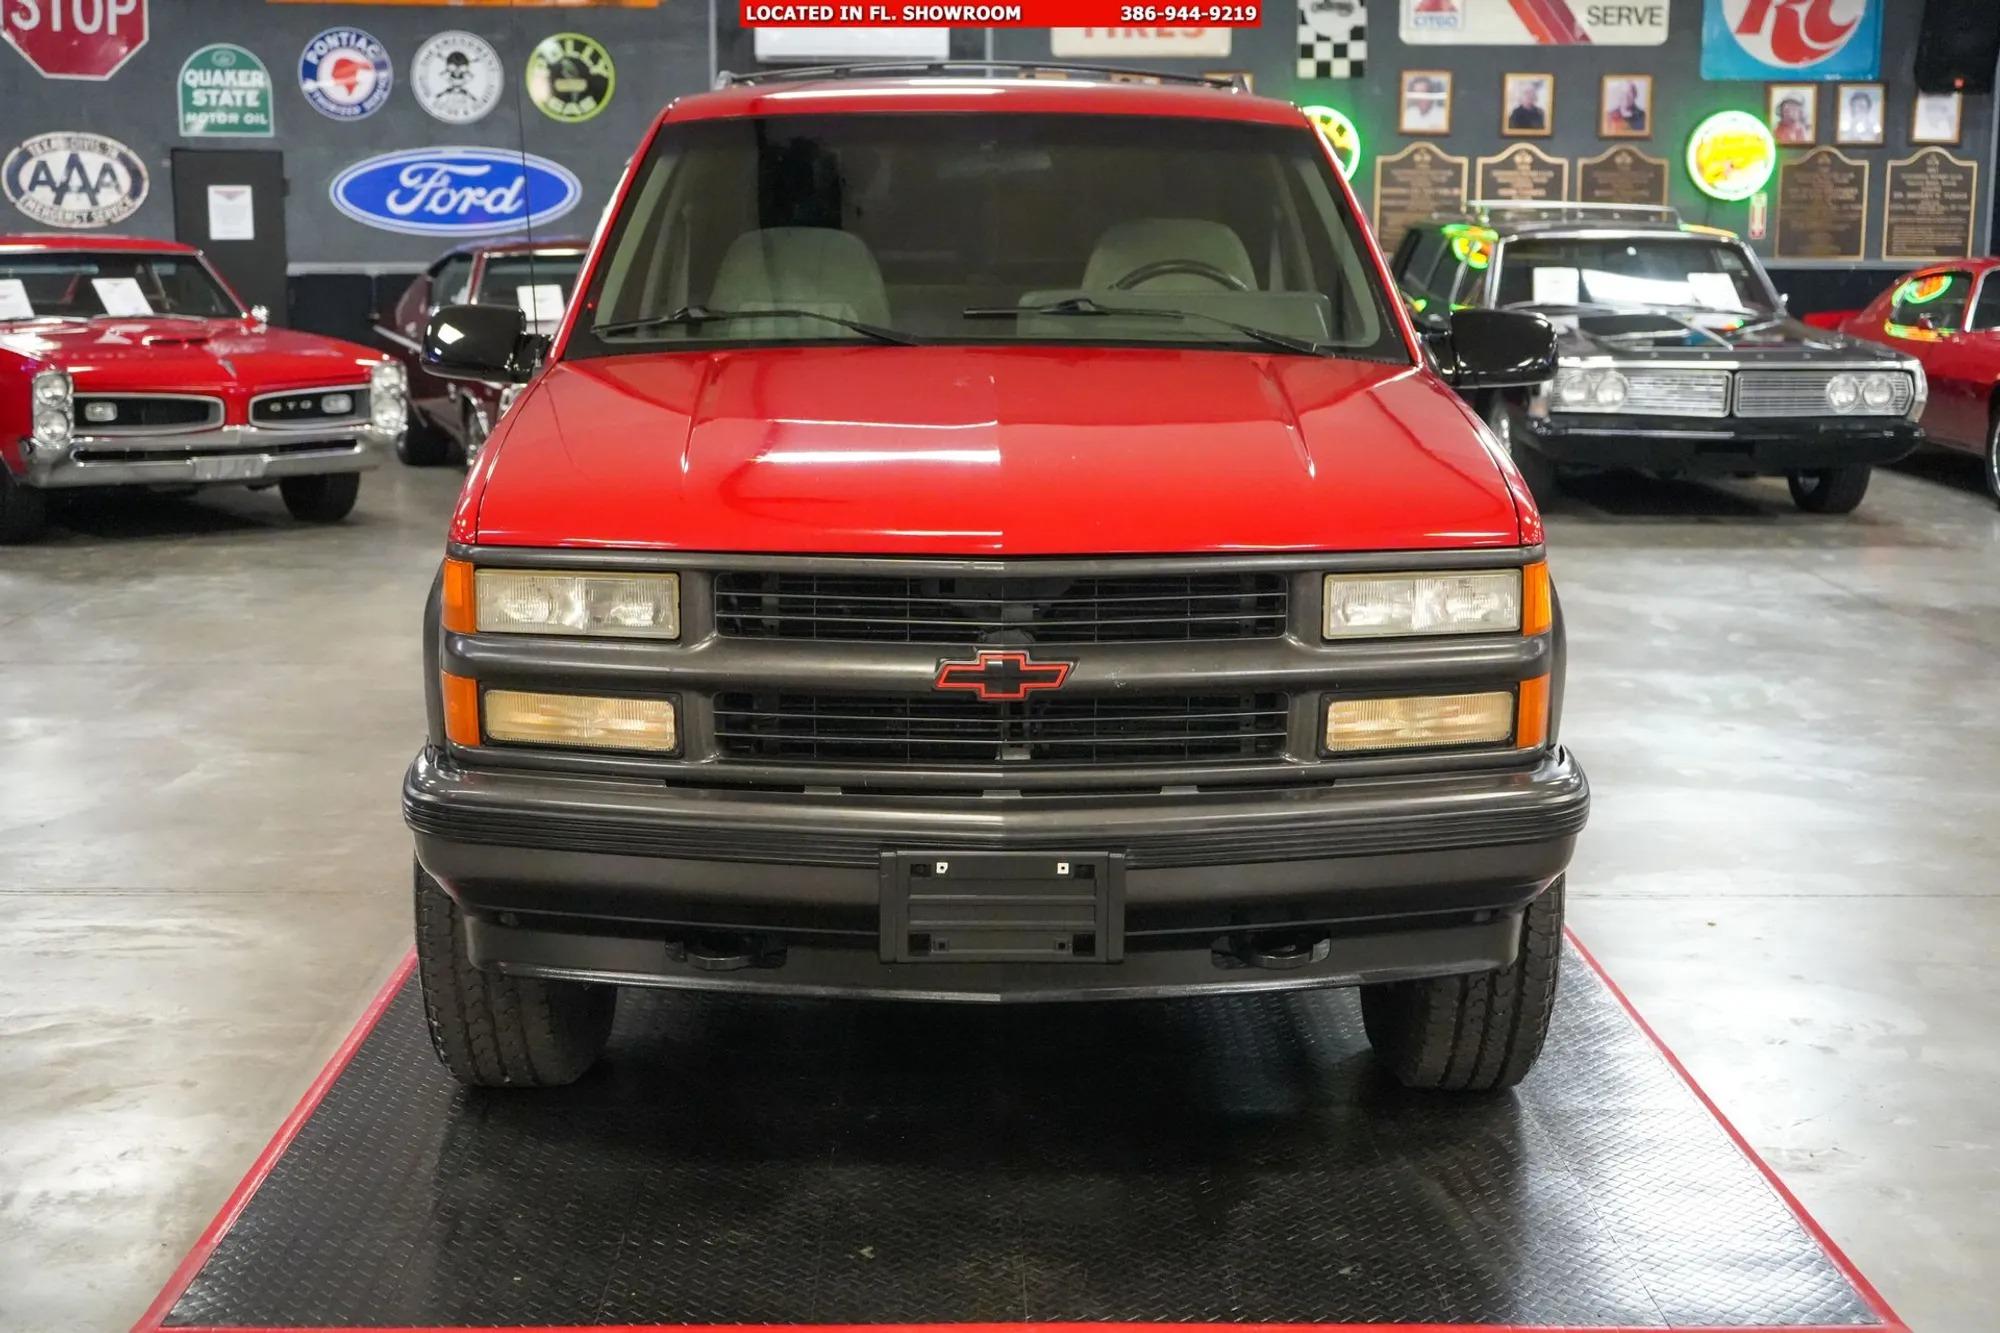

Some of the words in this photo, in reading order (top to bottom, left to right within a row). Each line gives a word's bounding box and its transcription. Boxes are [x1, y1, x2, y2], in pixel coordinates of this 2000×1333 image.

[11, 0, 137, 35] STOP
[1587, 6, 1662, 26] SERVE
[306, 32, 382, 64] PONTIAC
[184, 69, 265, 88] QUAKER
[192, 89, 260, 107] STATE
[547, 96, 597, 115] GAS
[185, 112, 239, 124] MOTOR
[243, 112, 267, 125] OIL
[28, 153, 121, 206] AAA
[386, 162, 526, 216] Ford
